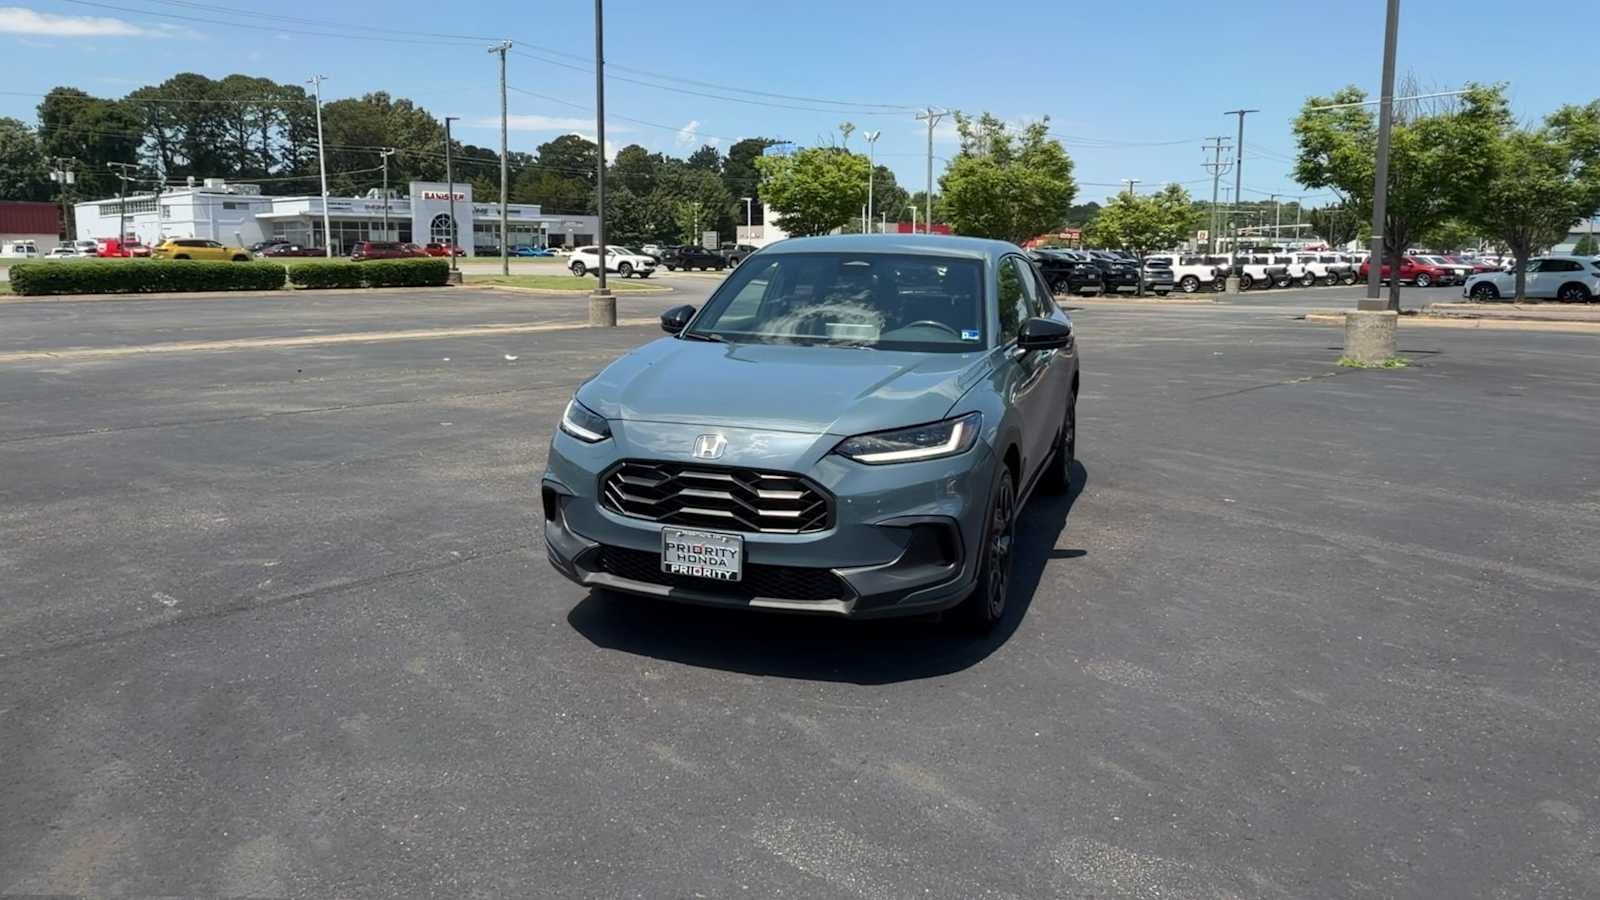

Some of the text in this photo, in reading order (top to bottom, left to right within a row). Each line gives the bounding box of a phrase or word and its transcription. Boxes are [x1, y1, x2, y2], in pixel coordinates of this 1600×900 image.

[424, 192, 464, 200] BANISER
[665, 542, 737, 559] PRIORITY
[676, 554, 728, 567] HONDA
[671, 564, 732, 580] PRIORITY
